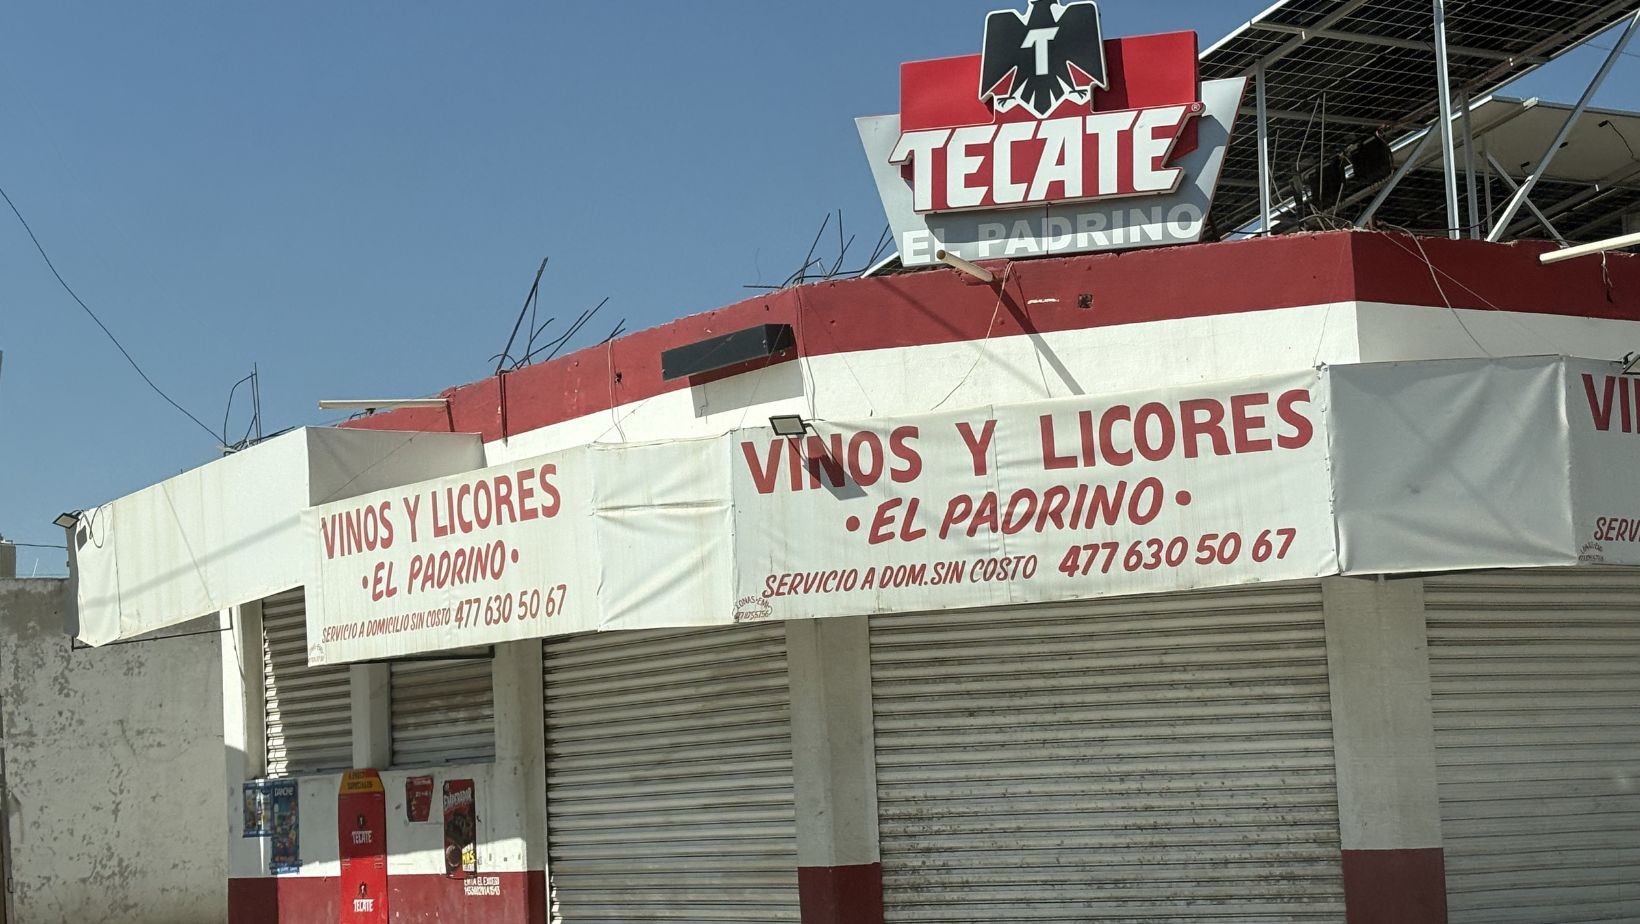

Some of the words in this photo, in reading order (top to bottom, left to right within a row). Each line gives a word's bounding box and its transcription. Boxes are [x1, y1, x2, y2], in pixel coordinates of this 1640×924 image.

[1020, 26, 1060, 75] T
[890, 105, 1187, 211] TECATE
[902, 226, 962, 264] EL
[978, 203, 1203, 257] PADRINO
[1581, 373, 1640, 433] VI
[741, 425, 924, 494] VINOS
[955, 419, 998, 476] Y
[1038, 388, 1314, 470] LICORES
[321, 500, 394, 560] VINOS
[403, 494, 421, 542] Y
[431, 463, 561, 538] LICORES
[868, 497, 927, 545] EL
[938, 476, 1164, 540] PADRINO
[1594, 516, 1640, 542] SERV
[372, 561, 398, 602] EL
[407, 539, 506, 594] PADRINO
[762, 574, 858, 598] SERVICIO
[861, 571, 876, 589] A
[970, 554, 1038, 583] COSTO
[1058, 541, 1120, 577] 477
[1123, 537, 1188, 571] 630
[1196, 531, 1241, 565] 50
[1251, 527, 1297, 561] 67
[321, 624, 358, 643] SERVICIO
[358, 626, 366, 638] A
[366, 615, 411, 637] DOMICILIO
[410, 611, 425, 630] SIN
[426, 606, 451, 627] COSTO
[454, 597, 482, 629] 477
[484, 592, 513, 626] 630
[518, 588, 541, 621] 50
[545, 583, 568, 618] 67
[353, 899, 374, 912] TECATE
